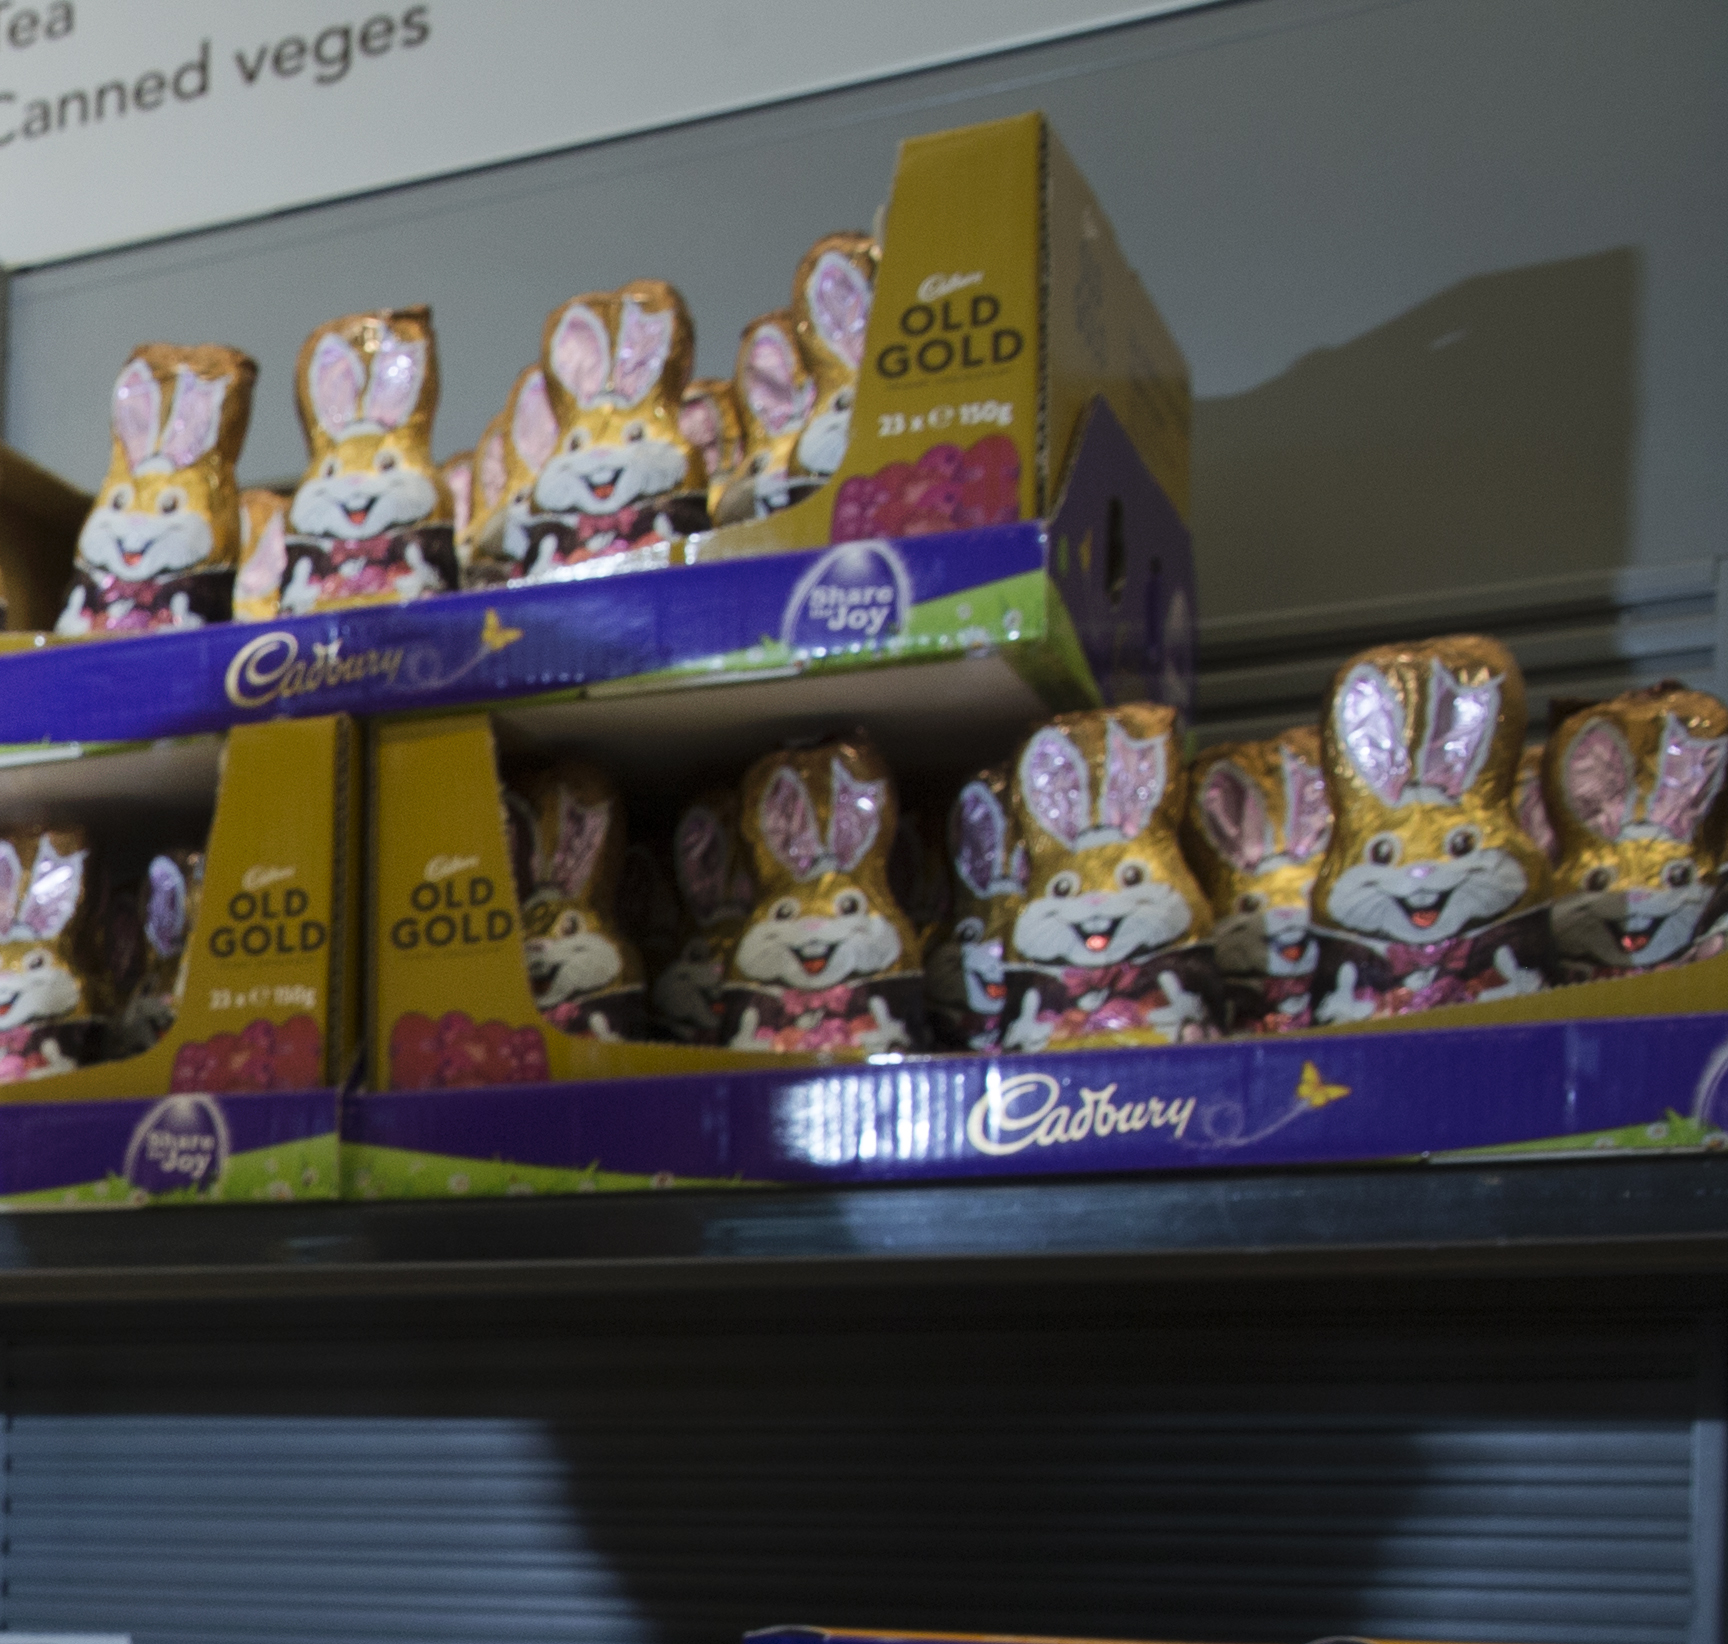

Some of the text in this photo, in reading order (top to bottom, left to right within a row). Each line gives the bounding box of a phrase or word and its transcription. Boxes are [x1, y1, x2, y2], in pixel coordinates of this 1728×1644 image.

[233, 5, 432, 86] veges
[900, 294, 1001, 337] OLD
[876, 329, 1024, 380] GOLD
[810, 582, 895, 609] Share
[829, 603, 890, 636] Joy
[225, 630, 406, 709] Cadbury
[228, 888, 310, 919] OLD
[410, 876, 493, 913] OLD
[209, 921, 327, 959] GOLD
[391, 911, 514, 951] GOLD
[967, 1071, 1196, 1157] Cadbury
[148, 1130, 215, 1154] Share
[162, 1149, 211, 1179] Joy
